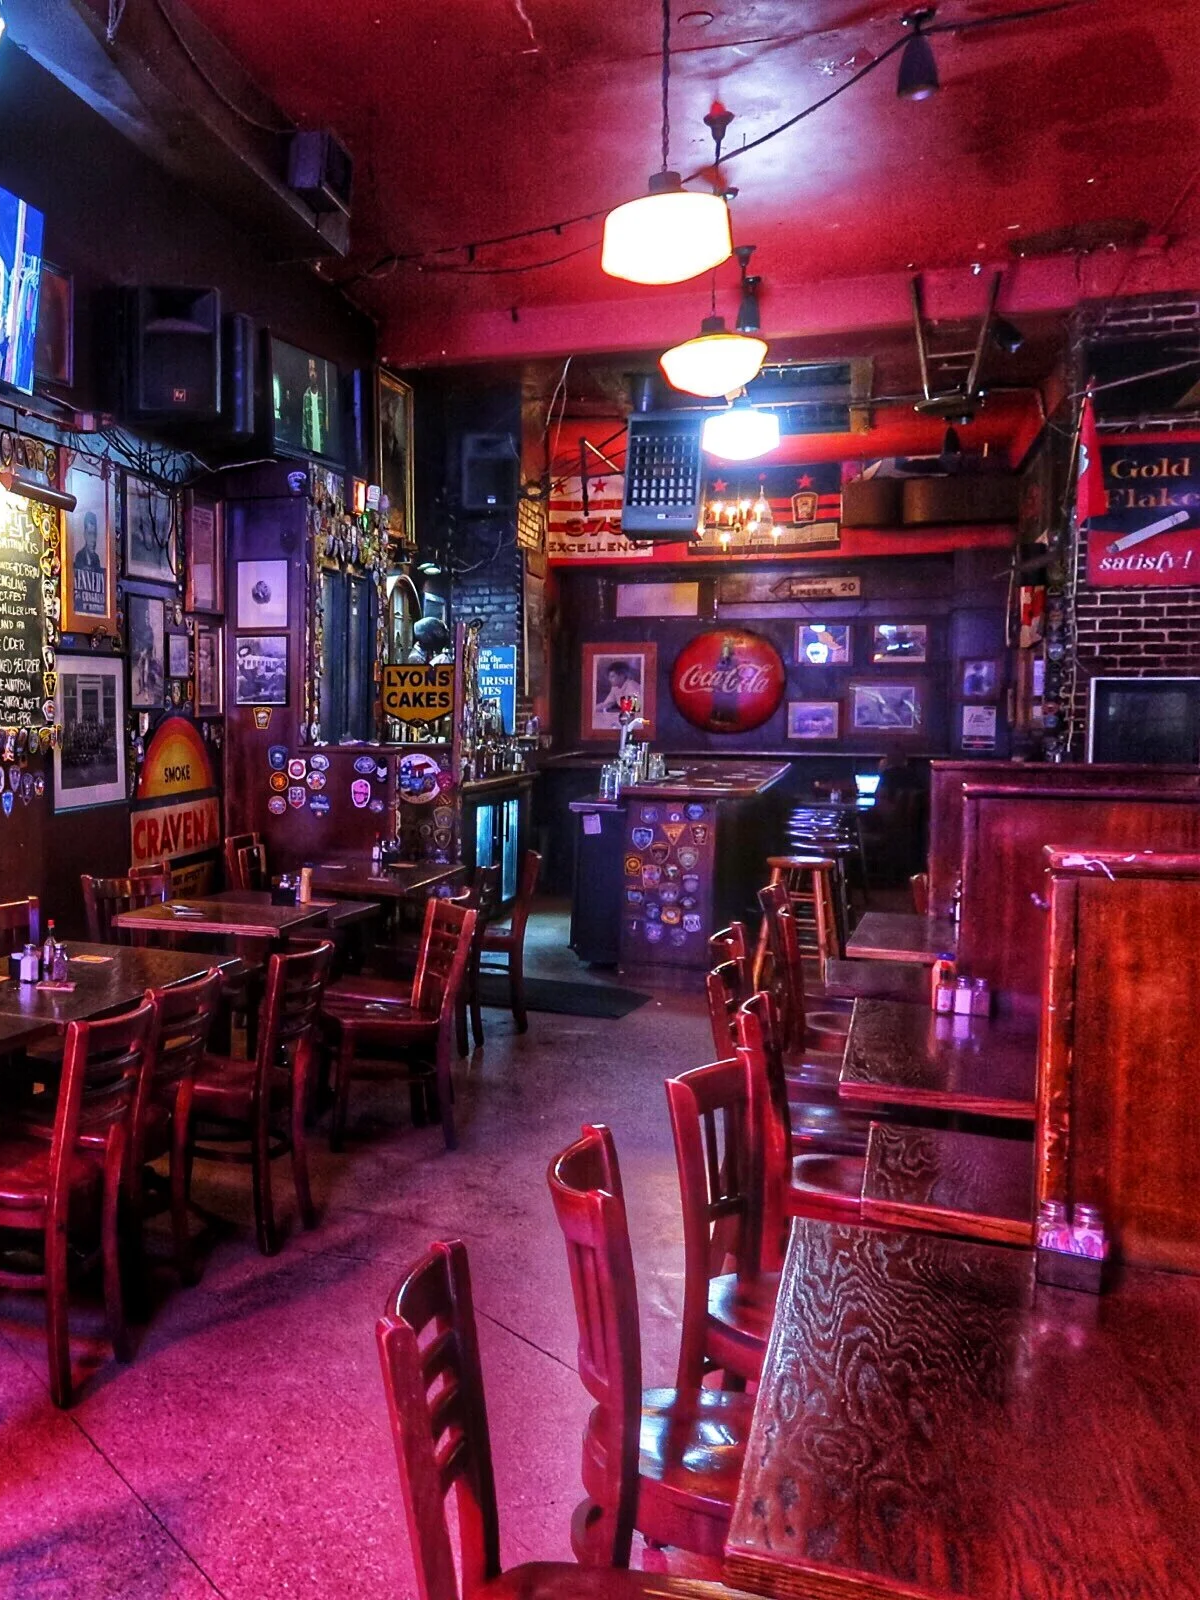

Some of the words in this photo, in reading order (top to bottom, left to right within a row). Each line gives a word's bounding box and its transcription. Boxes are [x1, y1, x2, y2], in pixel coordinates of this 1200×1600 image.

[1110, 457, 1192, 480] Gold
[1104, 487, 1200, 509] Flake
[790, 587, 834, 596] LIMERICK
[840, 582, 856, 592] 20
[1, 602, 24, 616] MILLER
[2, 635, 26, 652] CIDER
[482, 649, 492, 657] up
[490, 655, 503, 663] the
[13, 657, 41, 675] SELTZER
[493, 662, 514, 670] times
[481, 676, 513, 686] IRISH
[679, 663, 774, 694] Coca-Cola
[386, 691, 451, 708] CAKES
[163, 763, 191, 784] SMOKE
[133, 808, 205, 861] CRAVEN
